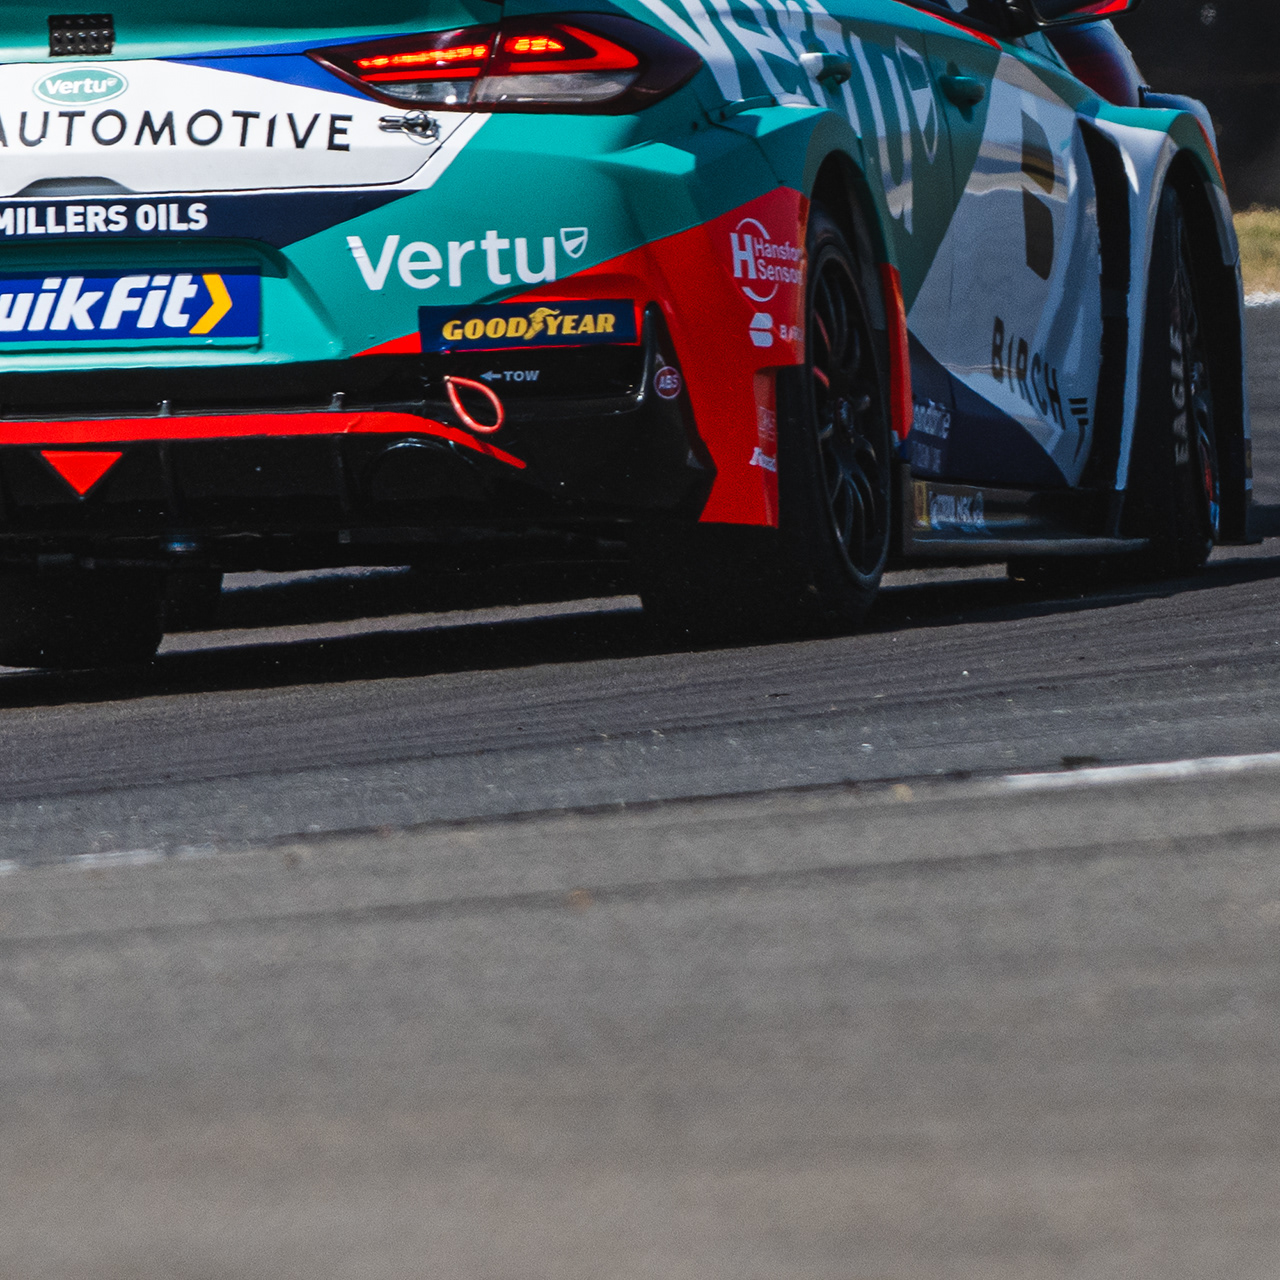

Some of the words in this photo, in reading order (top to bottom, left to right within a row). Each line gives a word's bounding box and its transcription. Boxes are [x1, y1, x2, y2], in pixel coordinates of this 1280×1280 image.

[44, 77, 109, 97] Vertu
[136, 202, 208, 231] OILS
[348, 228, 556, 290] Vertu
[504, 368, 540, 382] TOW
[658, 375, 679, 390] ABS
[991, 316, 1066, 431] BIRCH
